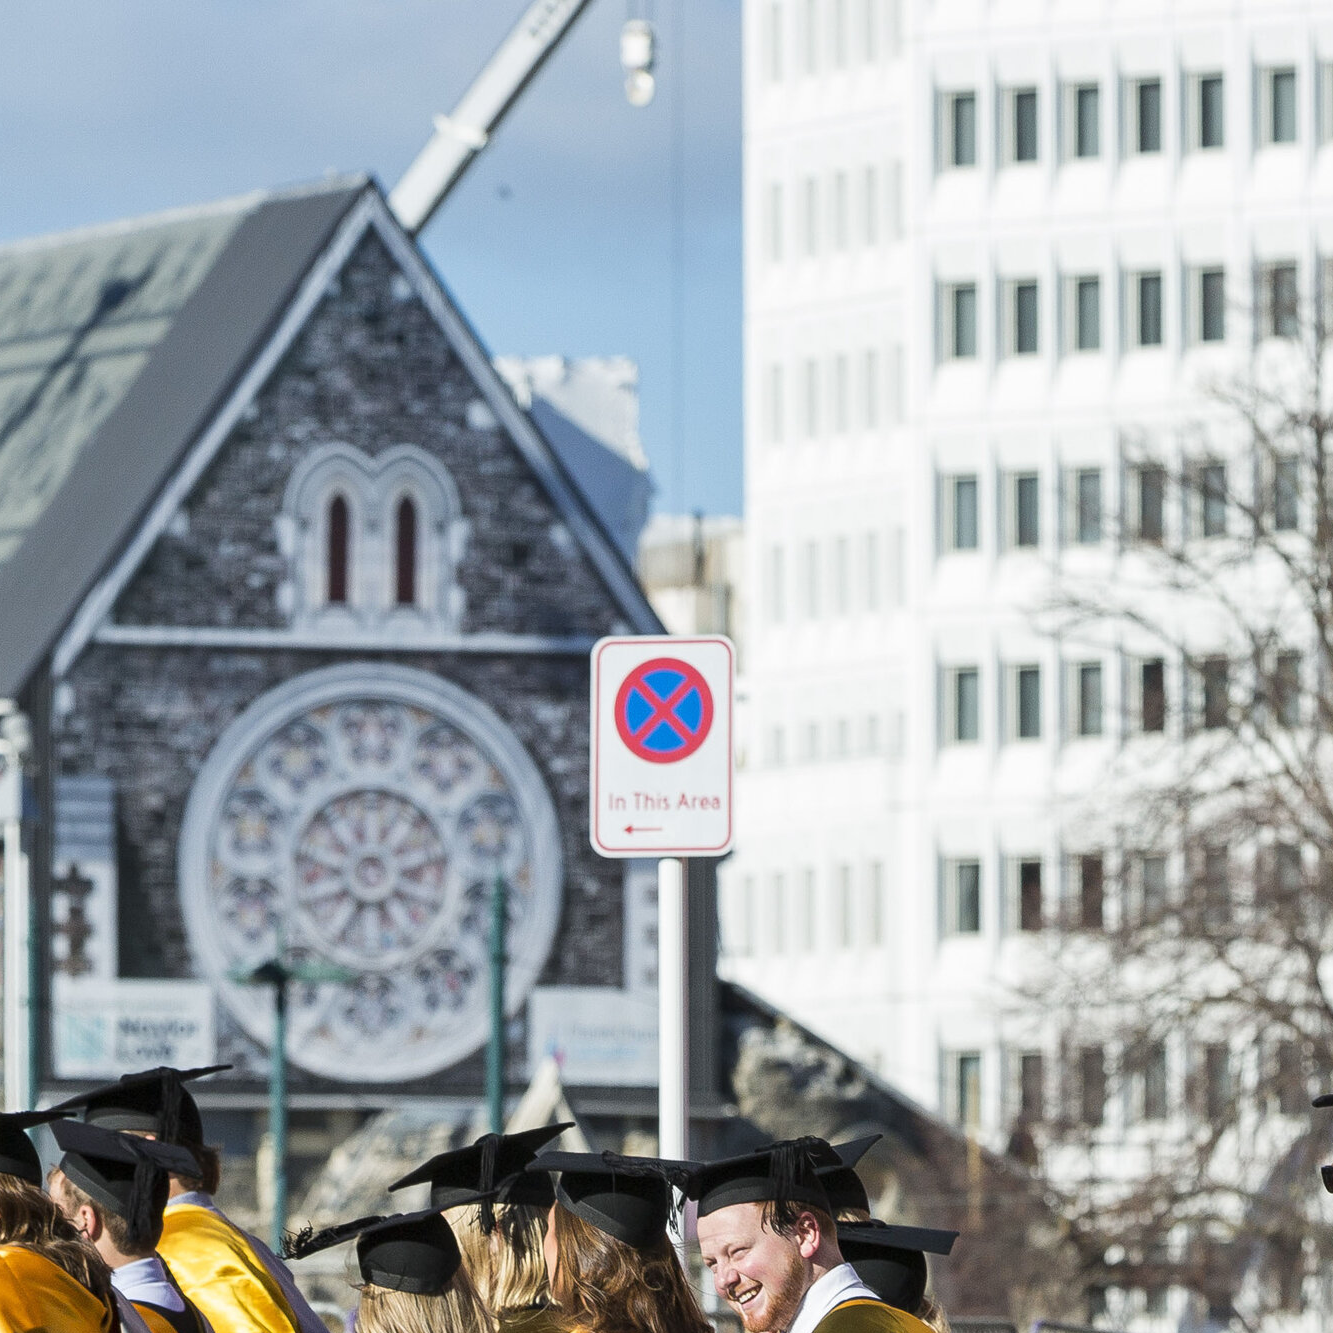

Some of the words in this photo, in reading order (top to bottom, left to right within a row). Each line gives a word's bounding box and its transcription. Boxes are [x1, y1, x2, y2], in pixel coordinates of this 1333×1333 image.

[608, 792, 627, 811] In
[633, 791, 670, 811] This
[675, 791, 721, 811] Area
